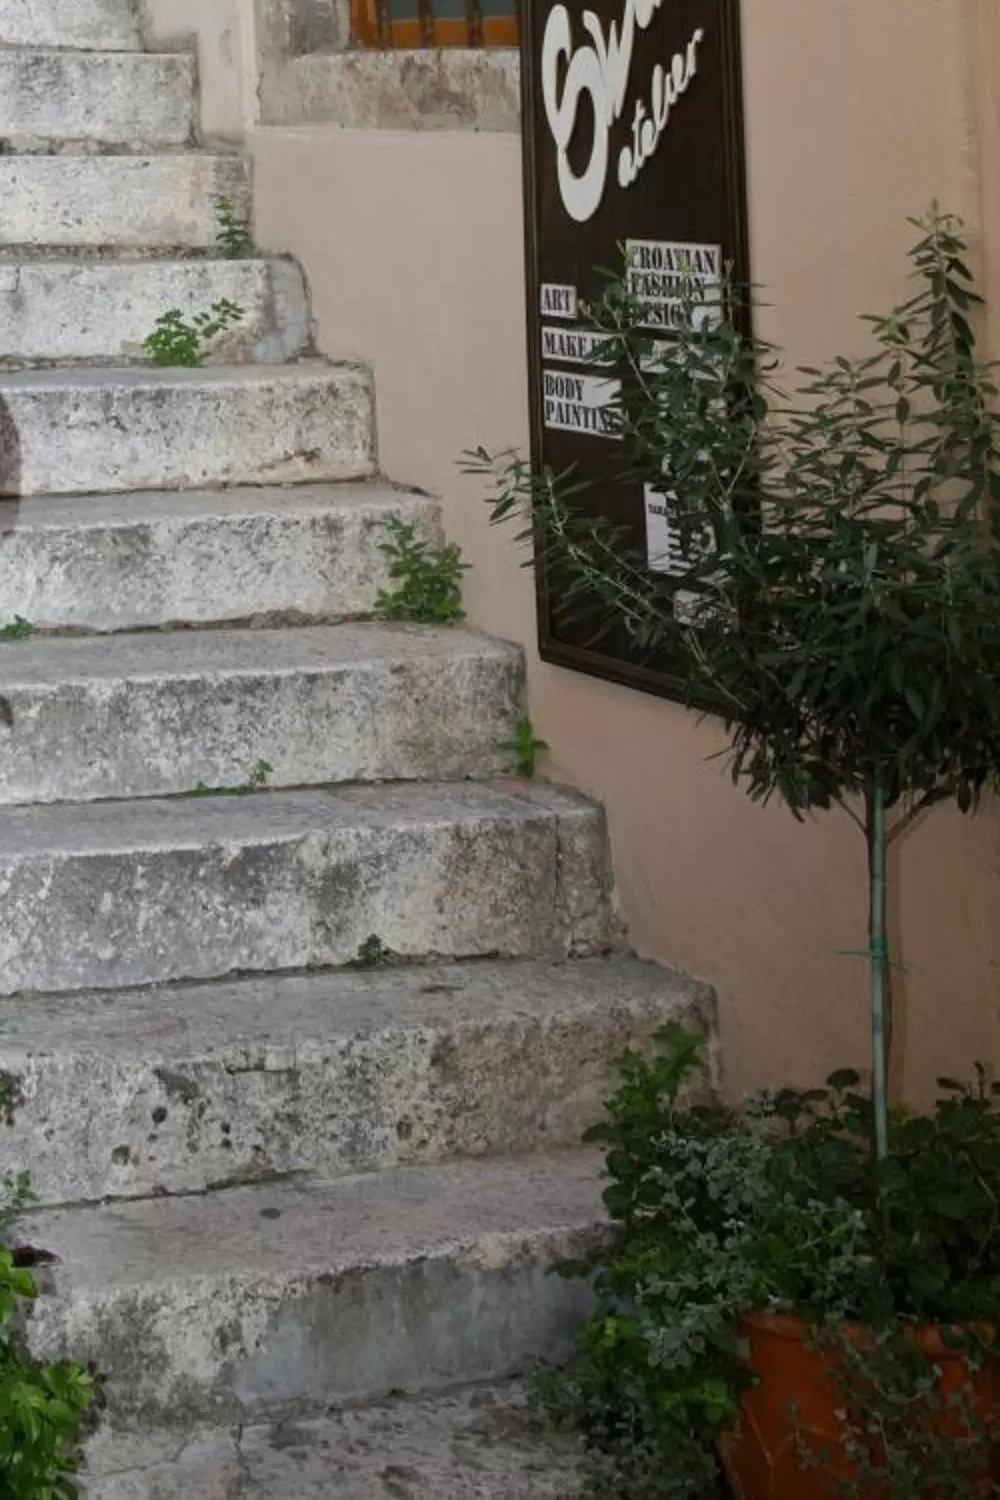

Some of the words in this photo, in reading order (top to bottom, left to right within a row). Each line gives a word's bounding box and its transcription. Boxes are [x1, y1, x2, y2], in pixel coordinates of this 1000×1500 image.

[617, 27, 703, 189] atelier
[543, 287, 571, 312] ART
[633, 299, 693, 327] ESIG
[544, 332, 587, 358] MAKE
[544, 373, 584, 401] BODY
[545, 400, 622, 436] PAINTIN
